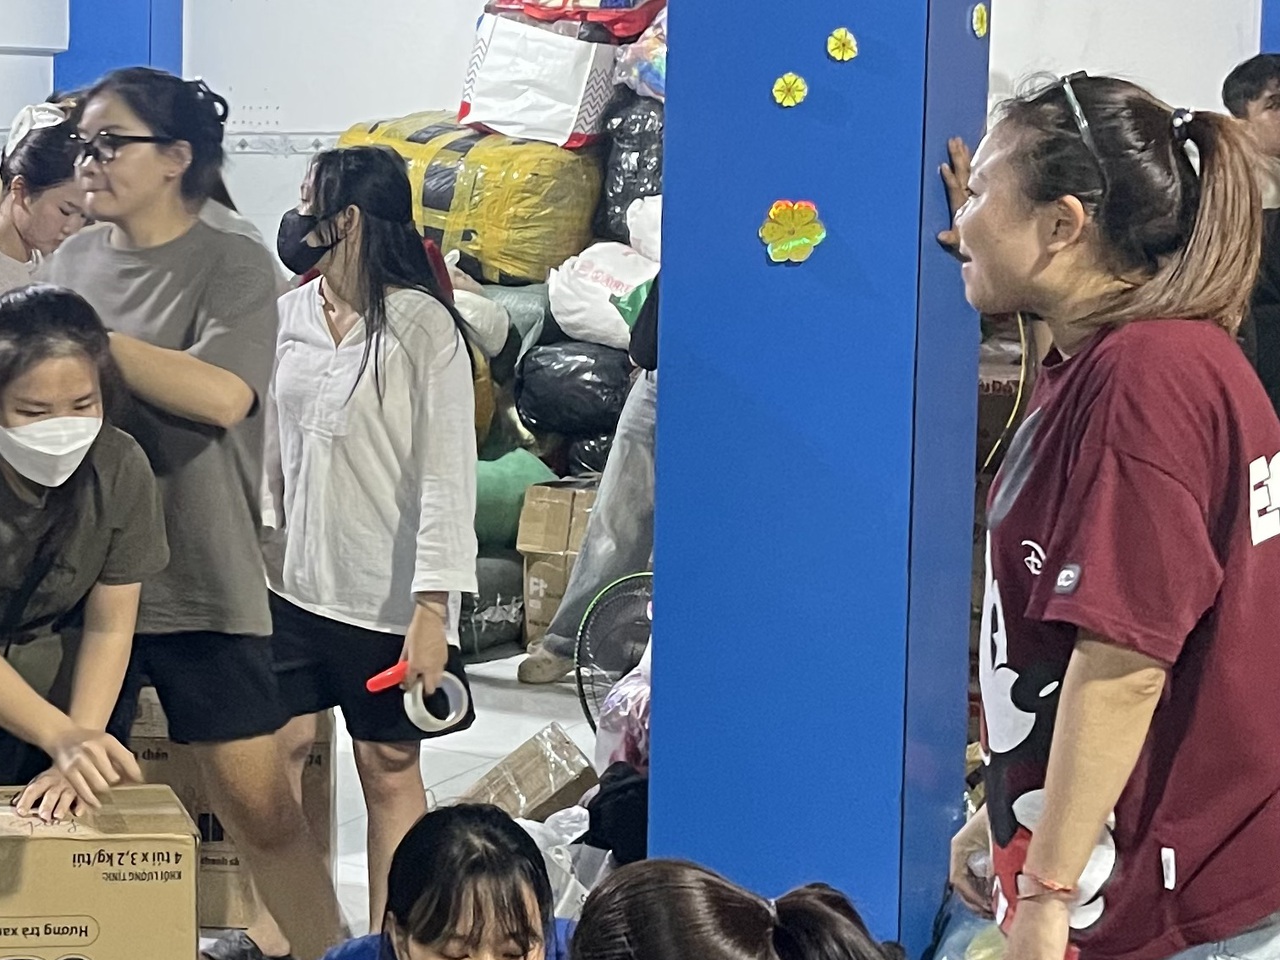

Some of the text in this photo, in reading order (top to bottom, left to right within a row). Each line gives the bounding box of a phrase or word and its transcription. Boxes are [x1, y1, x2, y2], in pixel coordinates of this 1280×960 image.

[72, 849, 183, 867] 4 túi x 3,2 kg/túi
[21, 926, 41, 940] trà
[44, 924, 89, 940] Hương
